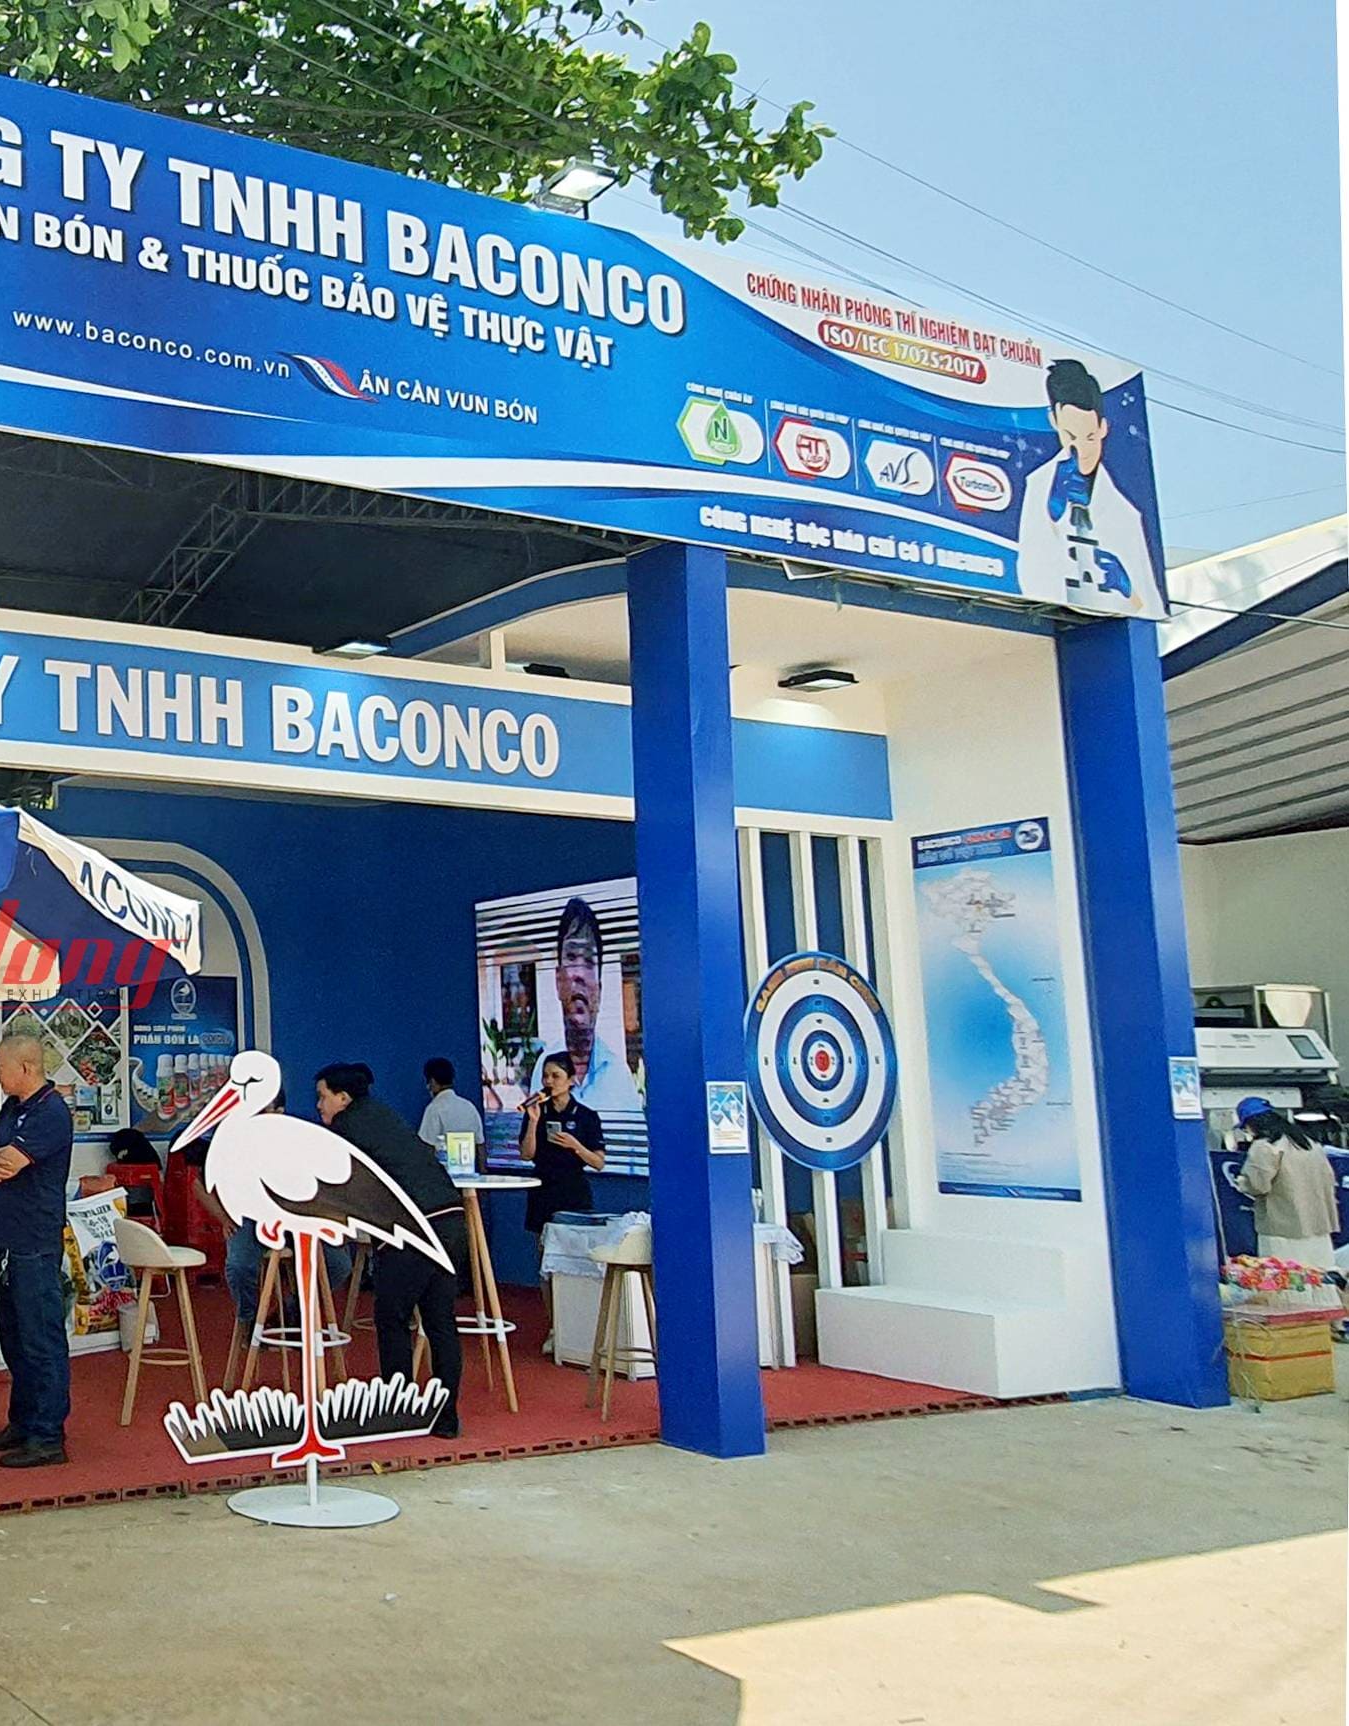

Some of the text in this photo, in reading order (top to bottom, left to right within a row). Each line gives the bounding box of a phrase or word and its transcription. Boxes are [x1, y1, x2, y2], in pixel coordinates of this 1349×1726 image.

[51, 130, 145, 211] TY
[168, 157, 363, 263] TNHH
[386, 209, 686, 335] BACONCO
[33, 213, 124, 263] BÓN
[137, 236, 169, 273] &
[182, 244, 310, 299] THUỐC
[321, 271, 396, 320] BẢO
[406, 293, 449, 338] VỆ
[459, 305, 545, 355] THỰC
[554, 326, 614, 369] VẬT
[845, 297, 893, 328] PHÒNG
[13, 310, 291, 379] www.baconco.com.vn
[822, 323, 892, 356] ISO/IEC
[359, 369, 390, 396] ÂN
[446, 389, 489, 415] VUN
[494, 399, 539, 425] BÓN
[44, 658, 244, 747] TNHH
[271, 684, 560, 779] BACONCO
